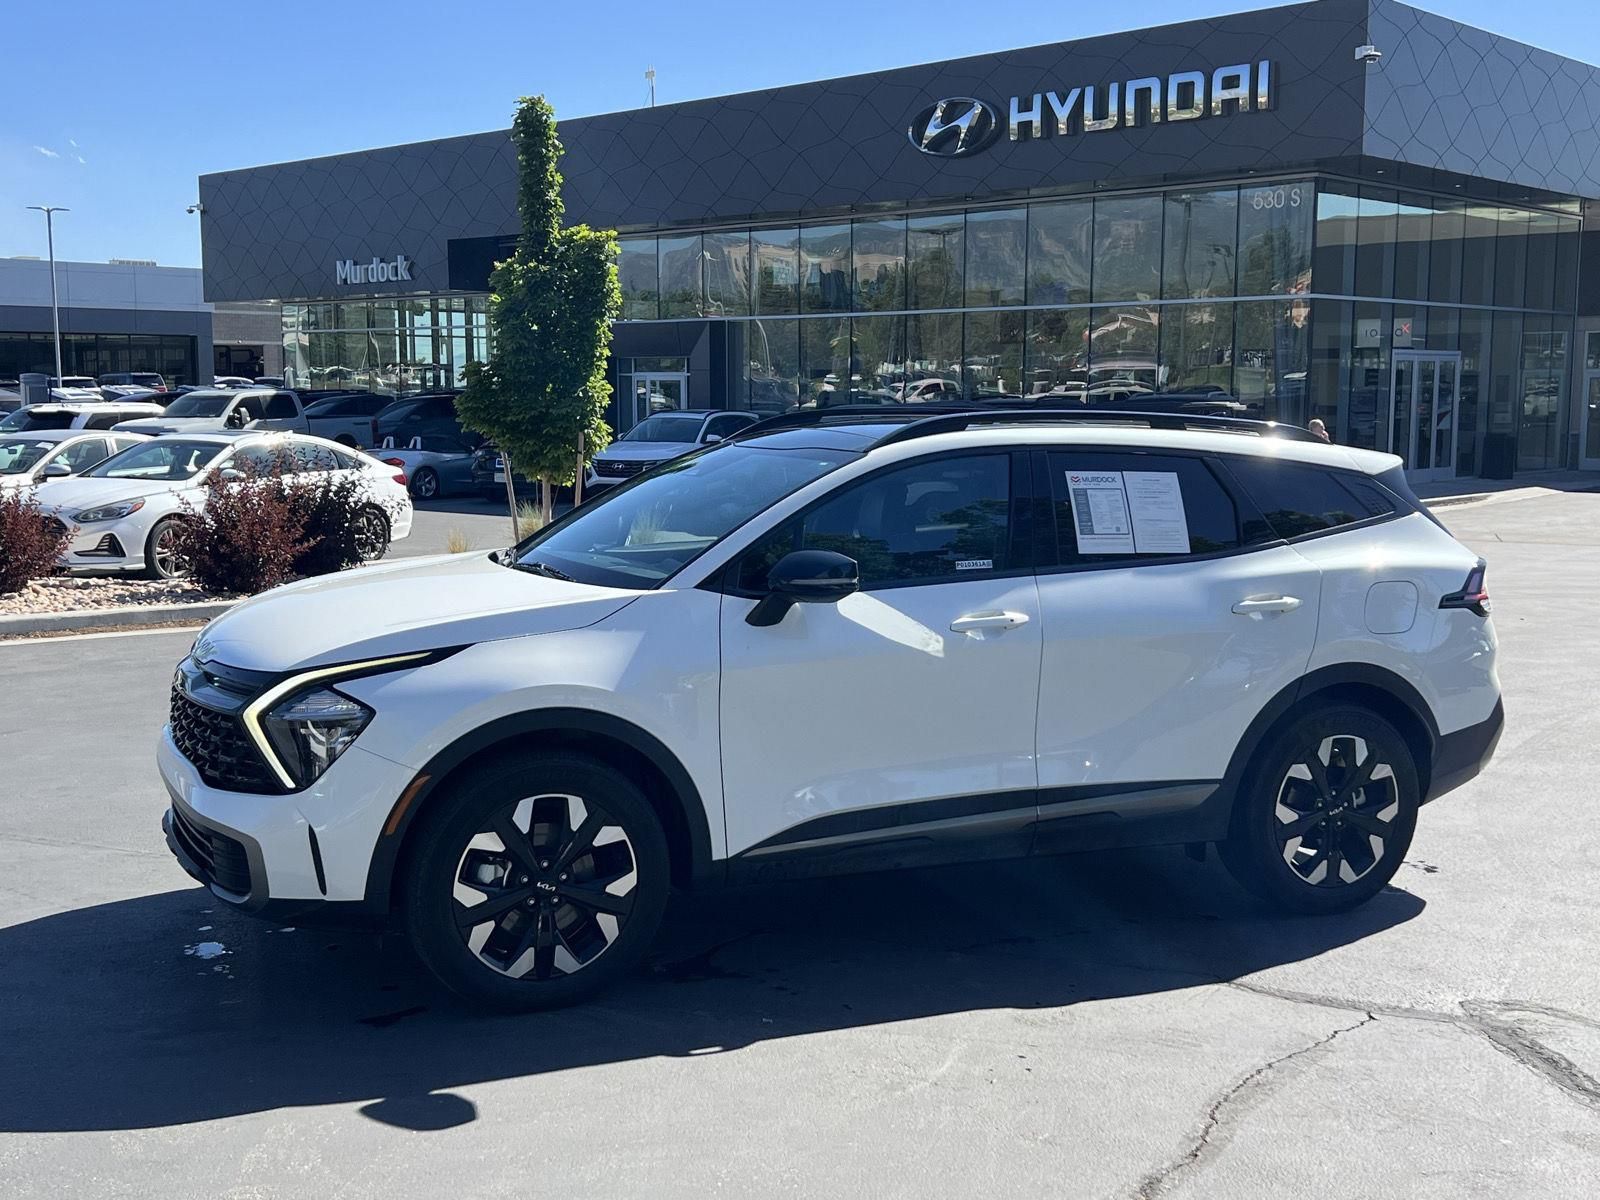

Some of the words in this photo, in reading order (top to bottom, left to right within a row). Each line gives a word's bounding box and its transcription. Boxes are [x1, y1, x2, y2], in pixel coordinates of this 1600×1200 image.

[1009, 60, 1271, 141] HYUNDAI
[1253, 190, 1285, 210] 630
[1290, 188, 1301, 207] S
[336, 255, 412, 285] Murdock
[1081, 475, 1117, 483] MURDOCK
